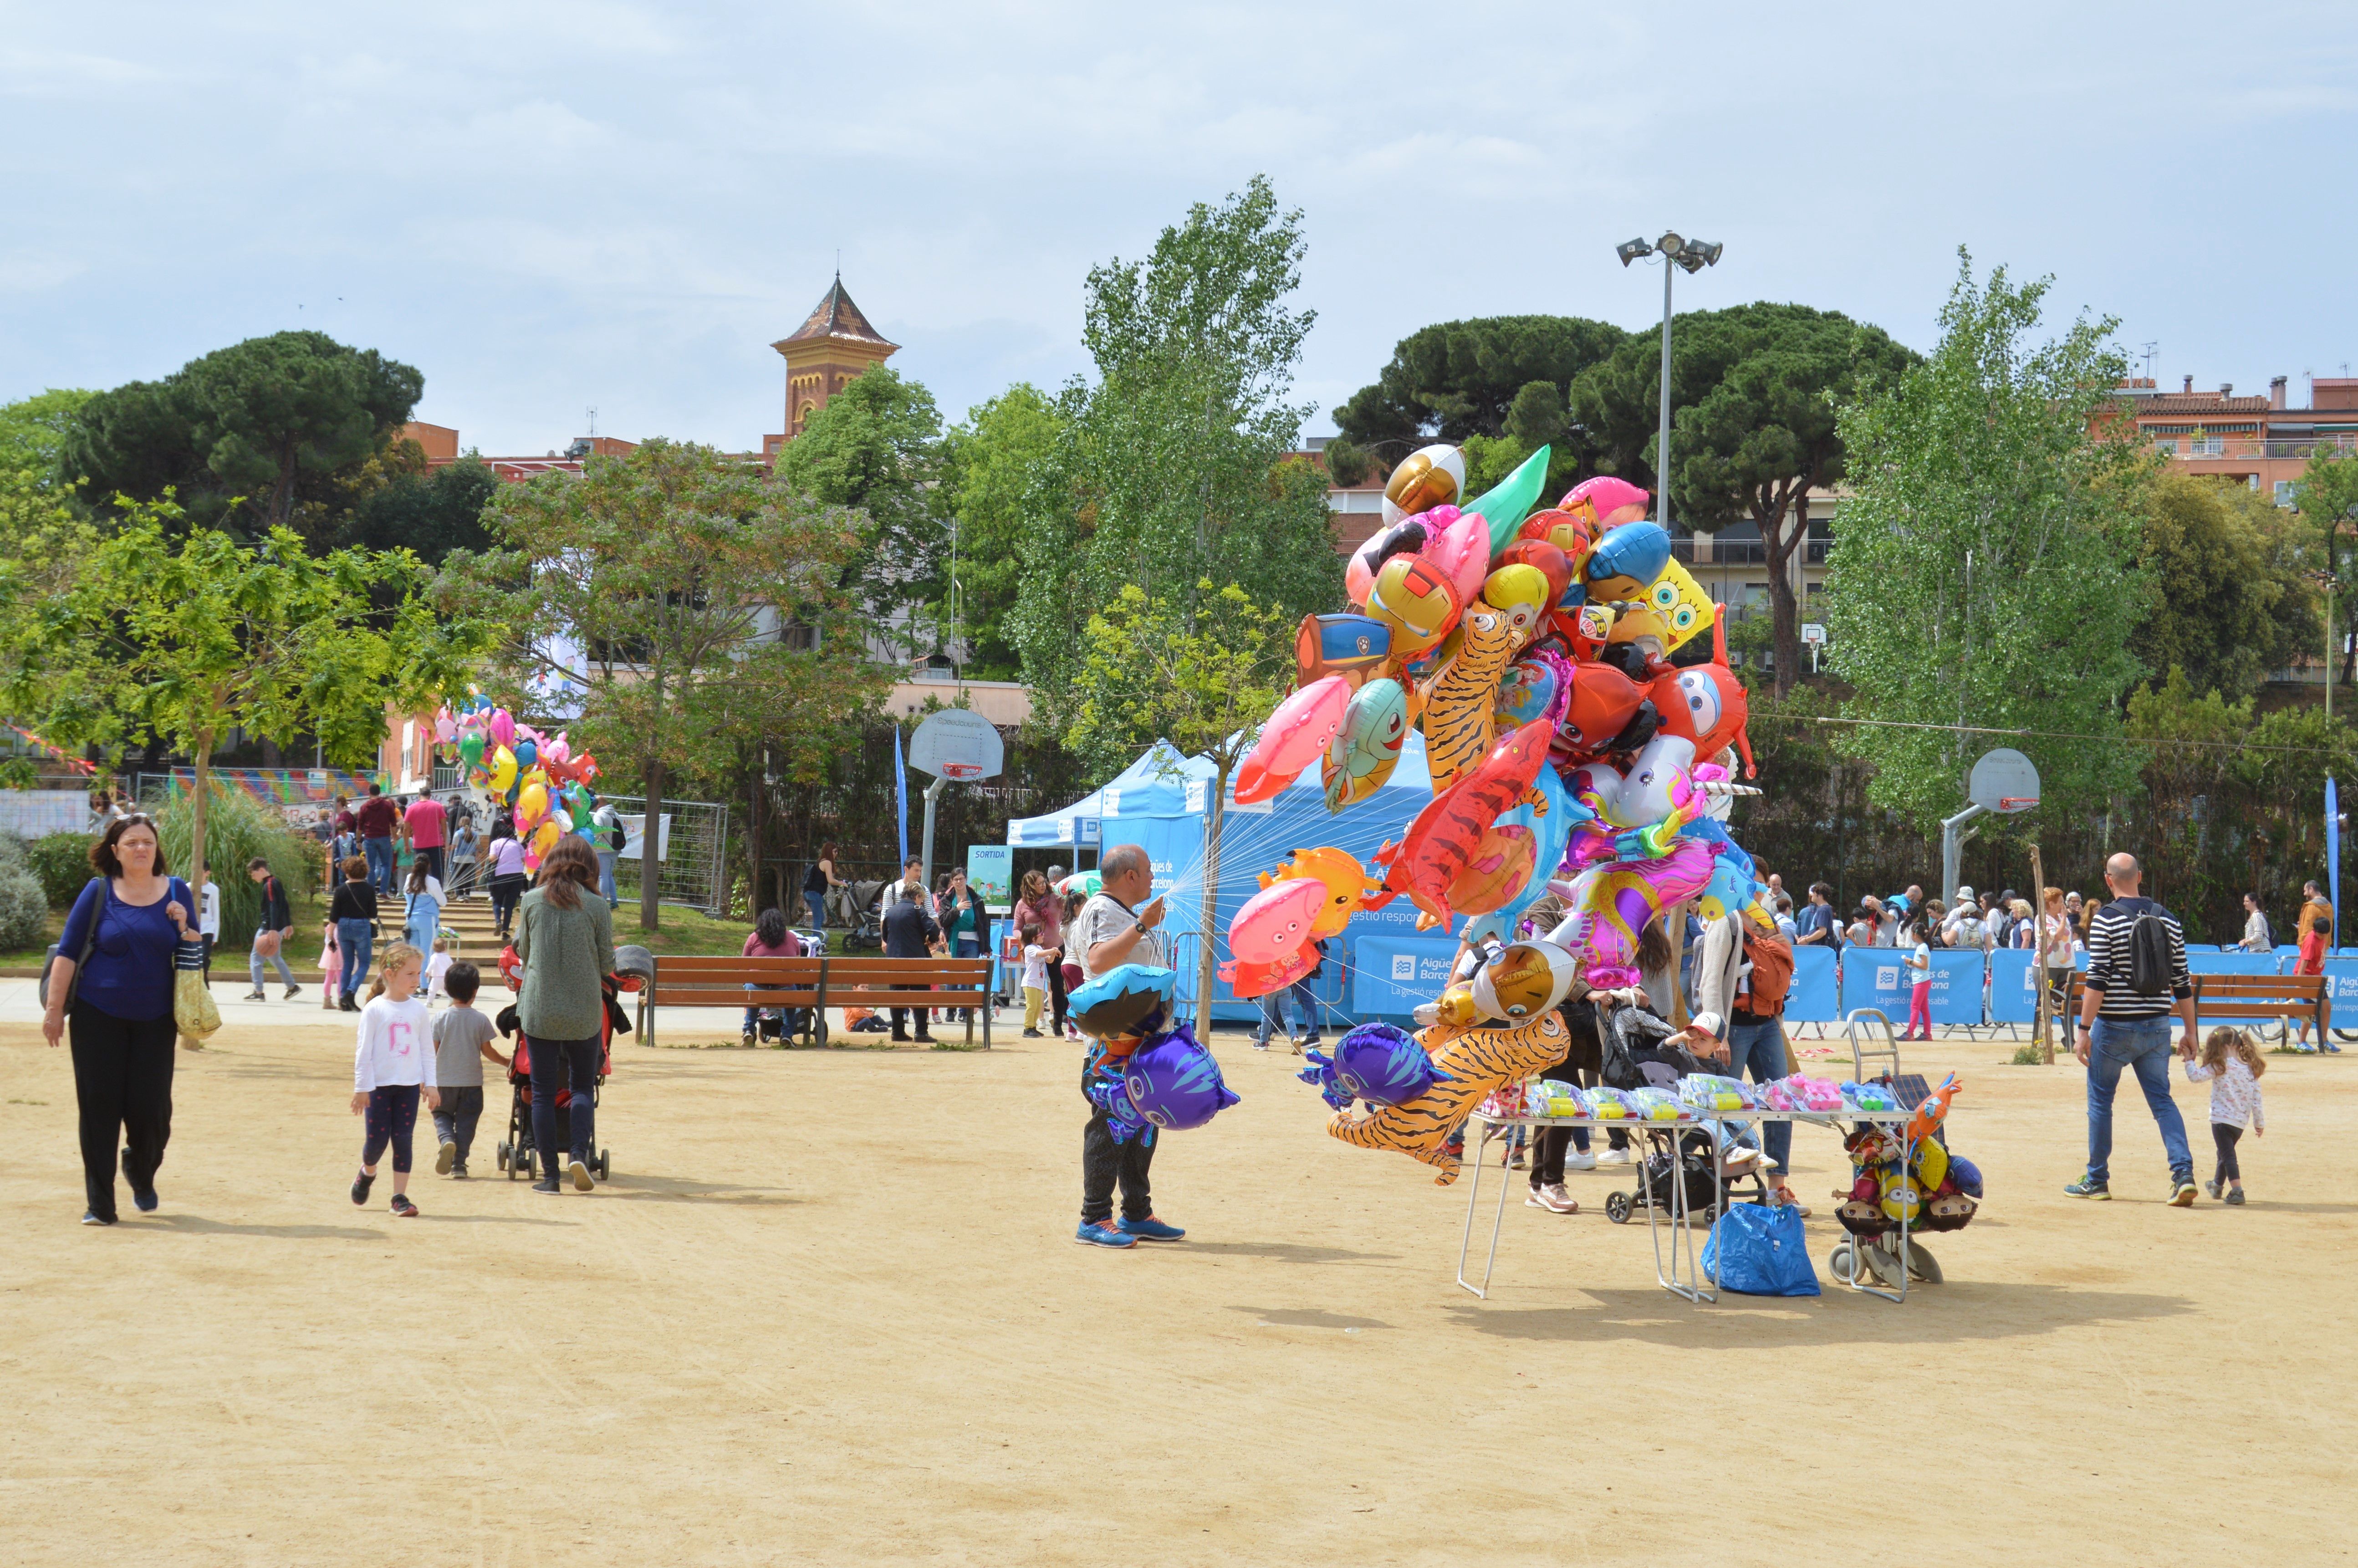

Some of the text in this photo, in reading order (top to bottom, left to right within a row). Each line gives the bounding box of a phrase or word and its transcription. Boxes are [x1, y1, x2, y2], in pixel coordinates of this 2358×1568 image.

[937, 717, 981, 728] Speedcourts
[975, 850, 1005, 858] SORTIDA
[1150, 860, 1173, 876] igües de
[1151, 877, 1174, 889] arcelona
[1382, 912, 1419, 925] respon
[1420, 958, 1453, 970] Aigüe
[1420, 970, 1450, 980] Barce
[1903, 969, 1950, 978] Aes de
[1902, 980, 1949, 990] Baona
[2339, 977, 2358, 988] Aigü
[1391, 986, 1400, 995] La
[1401, 986, 1424, 997] gestió
[1876, 996, 1949, 1006] La gestió rnsable
[388, 1021, 411, 1056] C
